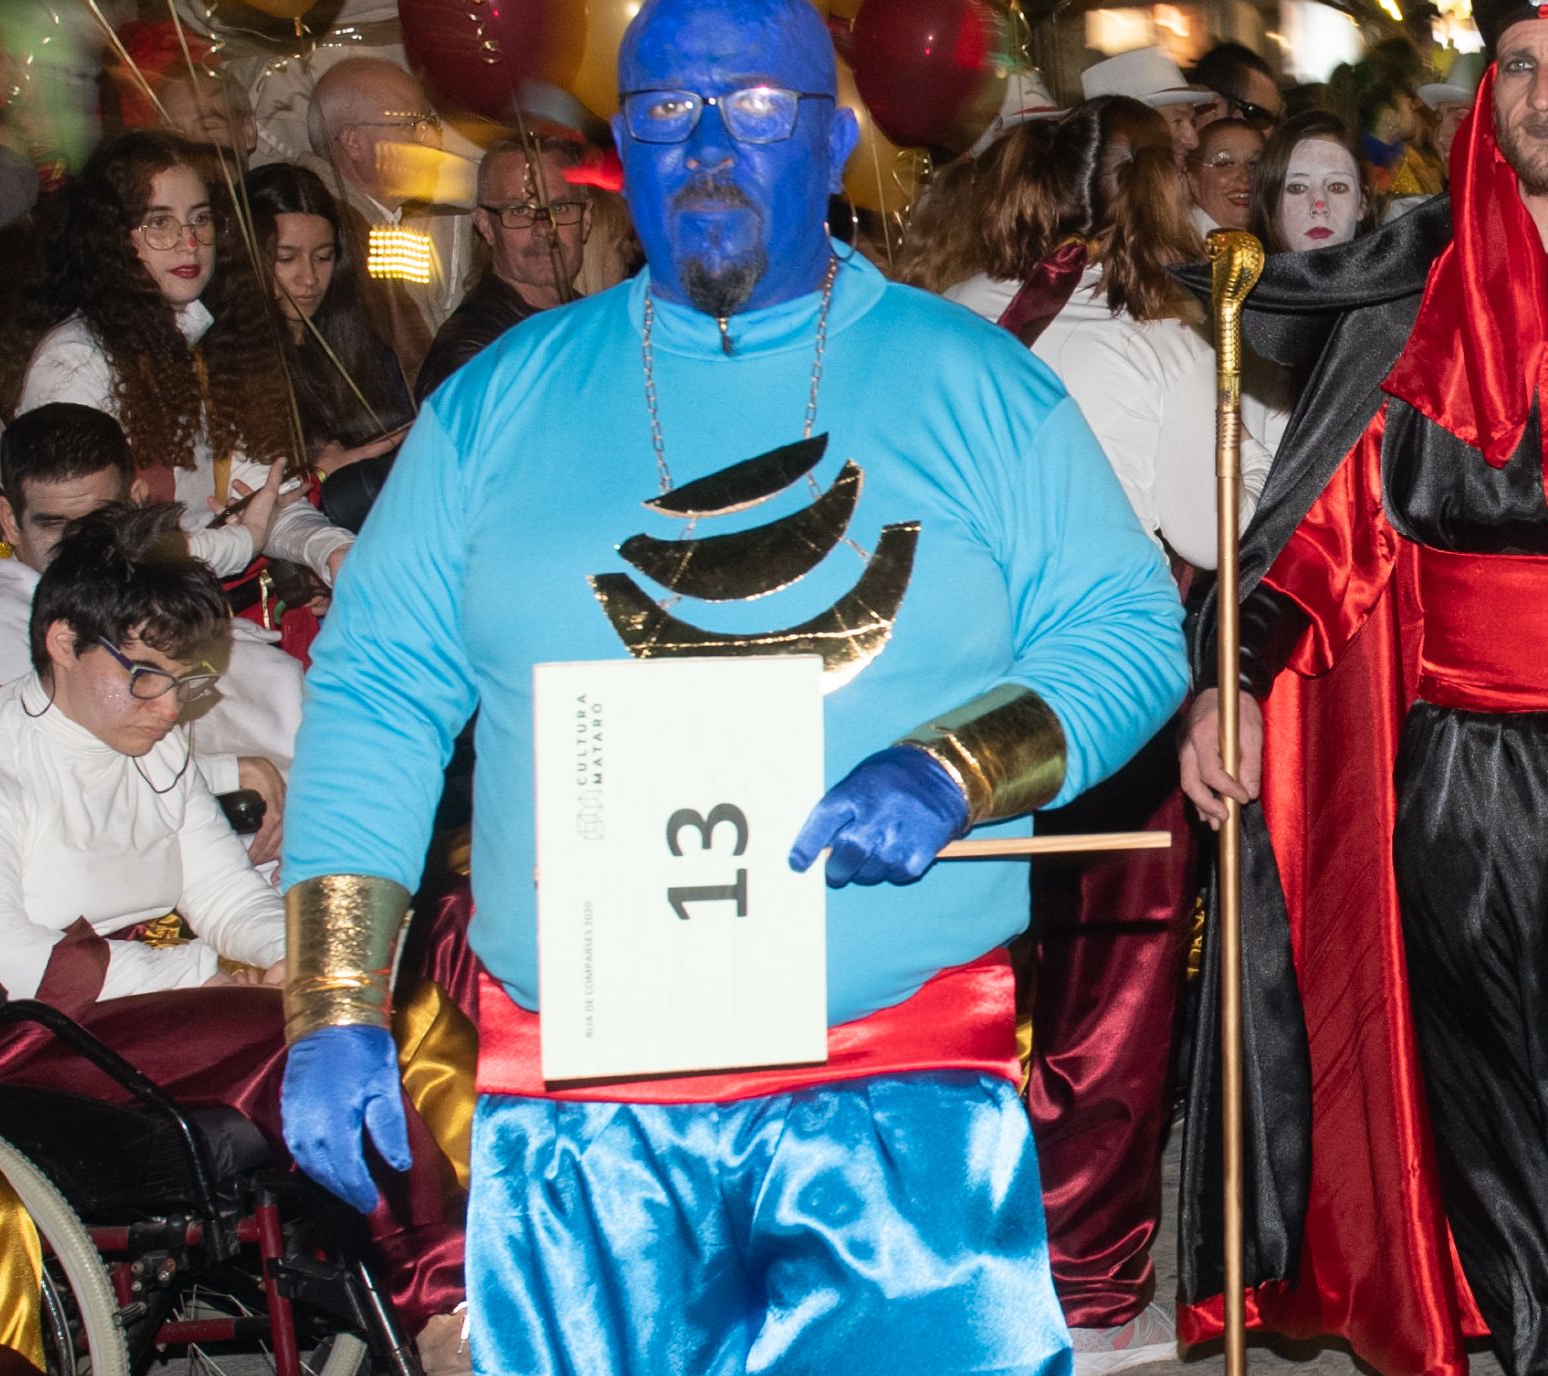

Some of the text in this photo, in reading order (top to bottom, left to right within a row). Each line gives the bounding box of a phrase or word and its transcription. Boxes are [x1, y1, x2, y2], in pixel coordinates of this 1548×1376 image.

[576, 694, 588, 785] CULTURA
[666, 803, 749, 920] 13
[583, 900, 595, 1038] RUA DE COMPARSES 2020
